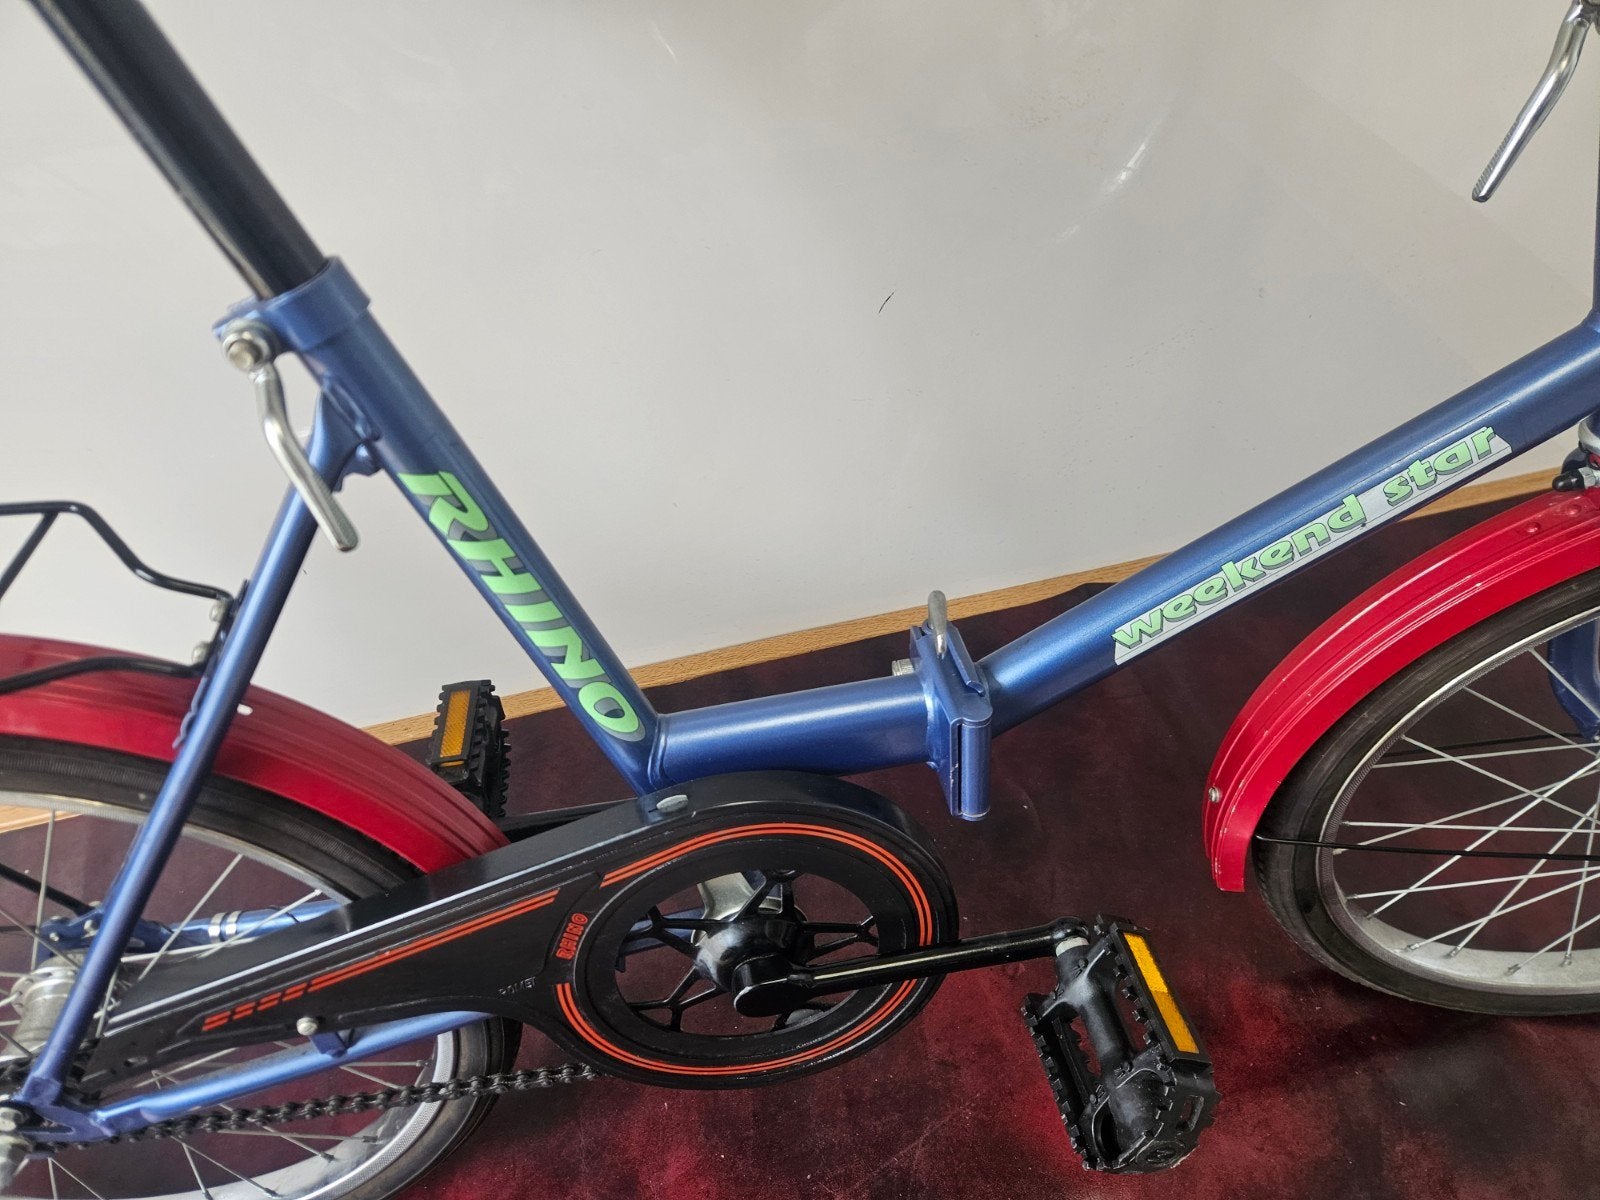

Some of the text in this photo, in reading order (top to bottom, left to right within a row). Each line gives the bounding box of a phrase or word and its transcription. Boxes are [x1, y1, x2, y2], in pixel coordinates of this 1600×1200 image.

[397, 471, 646, 742] RHINO
[1112, 426, 1496, 650] weekend star
[555, 912, 588, 960] RHINO
